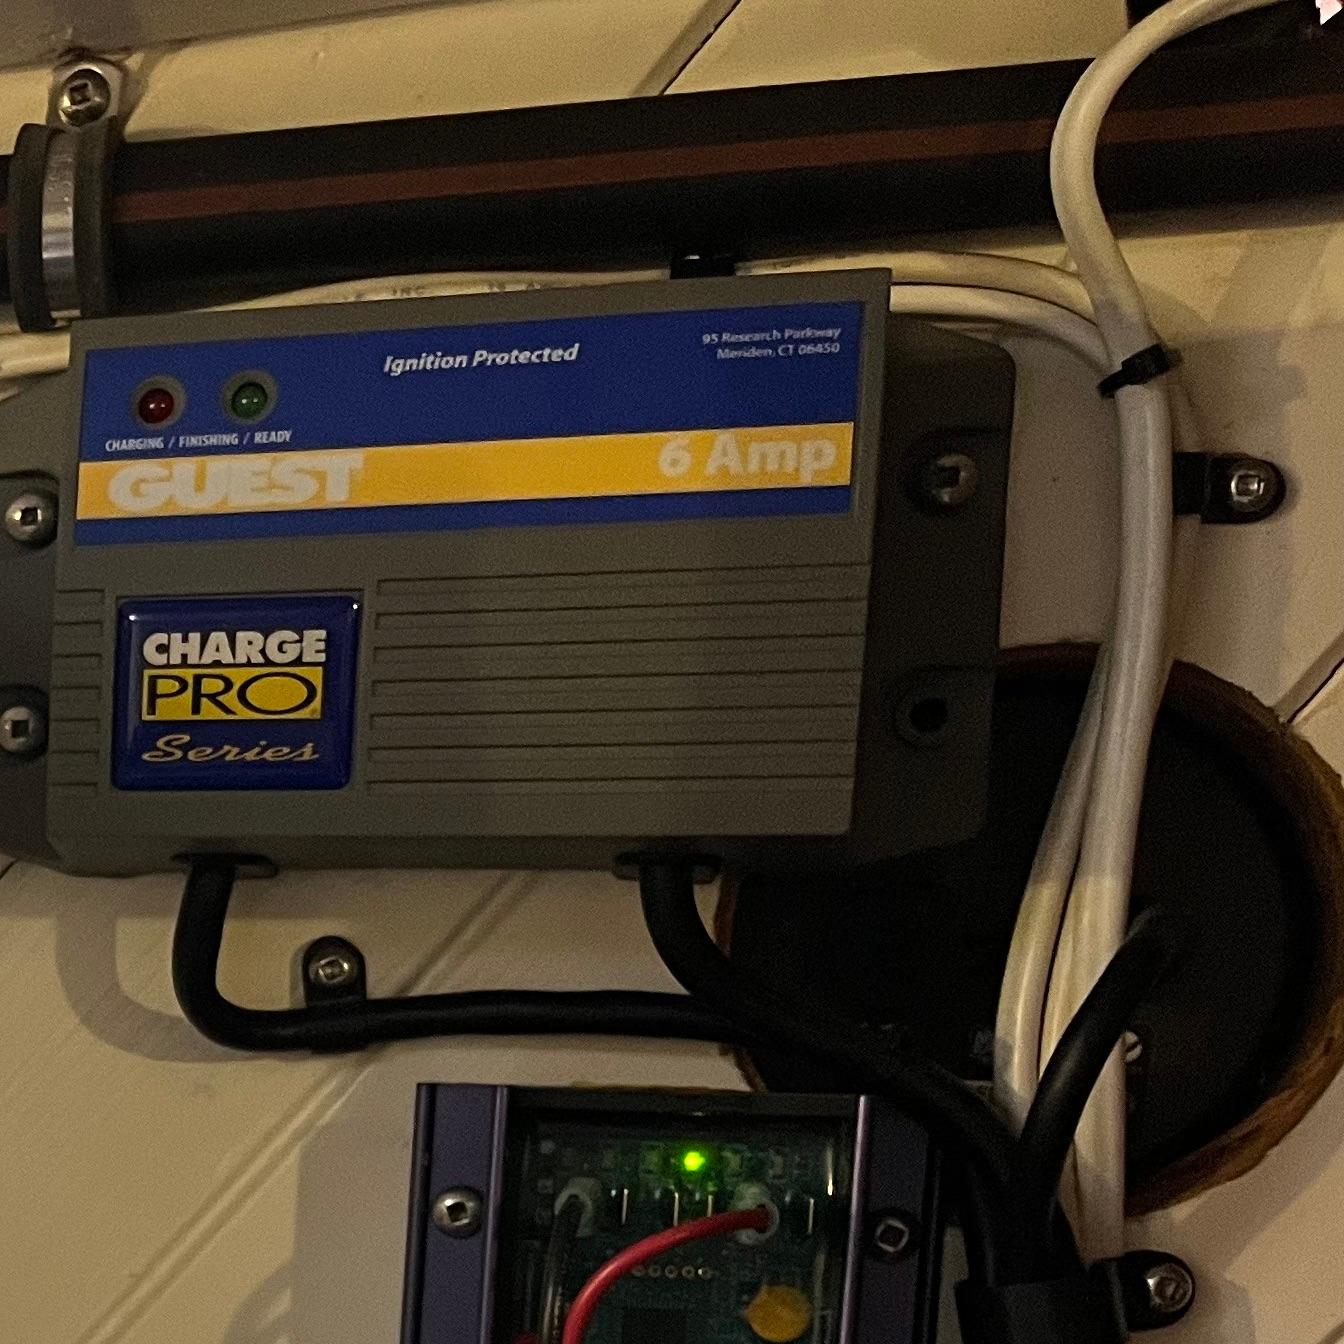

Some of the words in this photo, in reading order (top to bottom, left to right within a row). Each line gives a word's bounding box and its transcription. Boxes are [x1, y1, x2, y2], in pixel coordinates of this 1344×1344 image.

[720, 329, 782, 344] Research
[784, 326, 842, 342] Parkway
[777, 343, 794, 357] CT
[383, 353, 469, 376] Ignition
[472, 343, 579, 370] Protected
[104, 436, 165, 452] CHARGING
[178, 433, 239, 447] FINISHING
[254, 429, 293, 444] READY
[657, 432, 692, 478] 6
[704, 429, 839, 488] Amp
[106, 452, 364, 513] GUEST
[142, 629, 328, 666] CHARGE
[146, 671, 318, 716] PRO
[140, 733, 320, 762] Series
